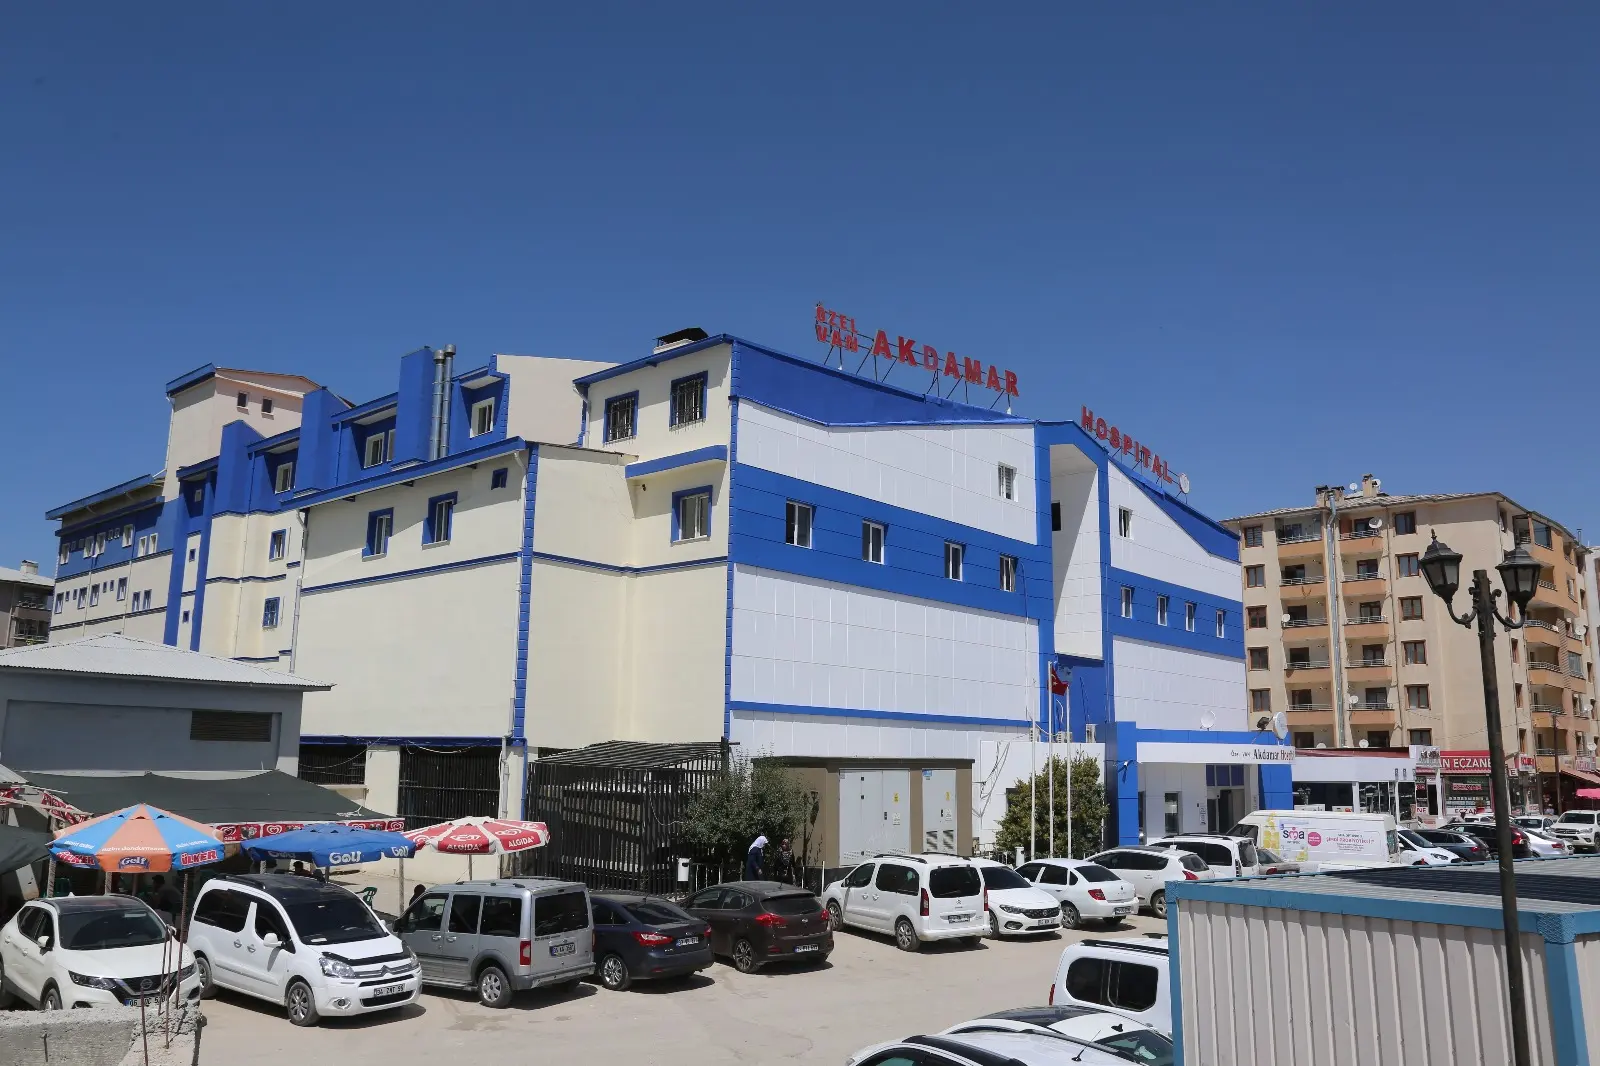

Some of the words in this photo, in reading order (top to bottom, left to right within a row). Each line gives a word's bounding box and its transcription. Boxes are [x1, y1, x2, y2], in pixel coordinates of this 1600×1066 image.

[816, 324, 858, 353] VAN
[872, 329, 1019, 397] AKDAMAR
[1081, 405, 1172, 484] HOSPITAL
[1253, 748, 1280, 760] Akdamar
[446, 843, 480, 851] ALGIDA
[508, 836, 535, 848] ALGIDA
[180, 850, 218, 866] ÜLKER
[328, 852, 361, 864] Golf
